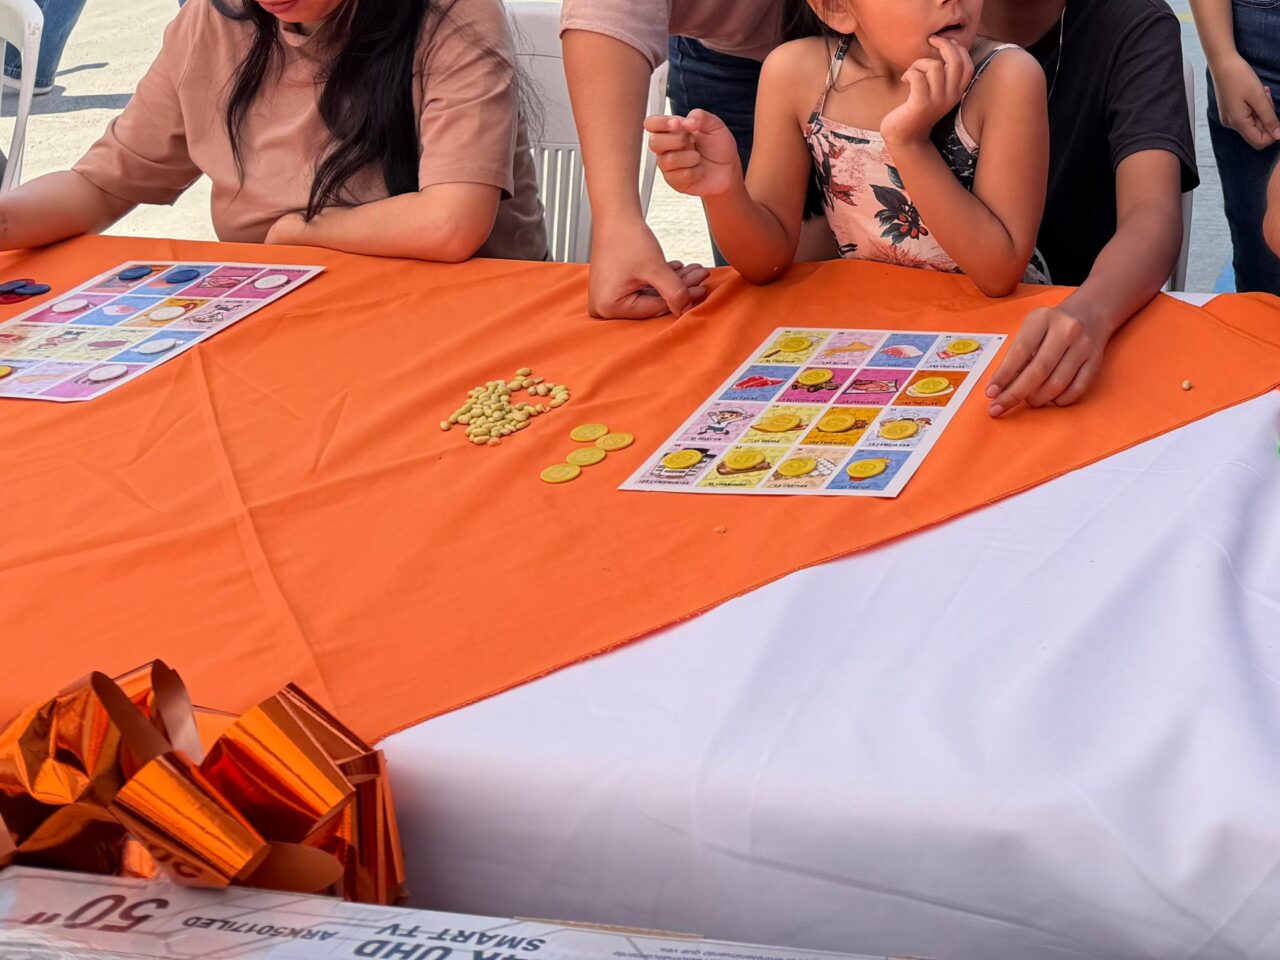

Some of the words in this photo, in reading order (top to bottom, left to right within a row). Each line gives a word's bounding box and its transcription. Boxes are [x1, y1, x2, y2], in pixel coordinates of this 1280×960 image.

[19, 894, 170, 934] 50"
[376, 922, 420, 938] TV
[428, 928, 546, 952] SMART
[352, 939, 453, 960] UHD
